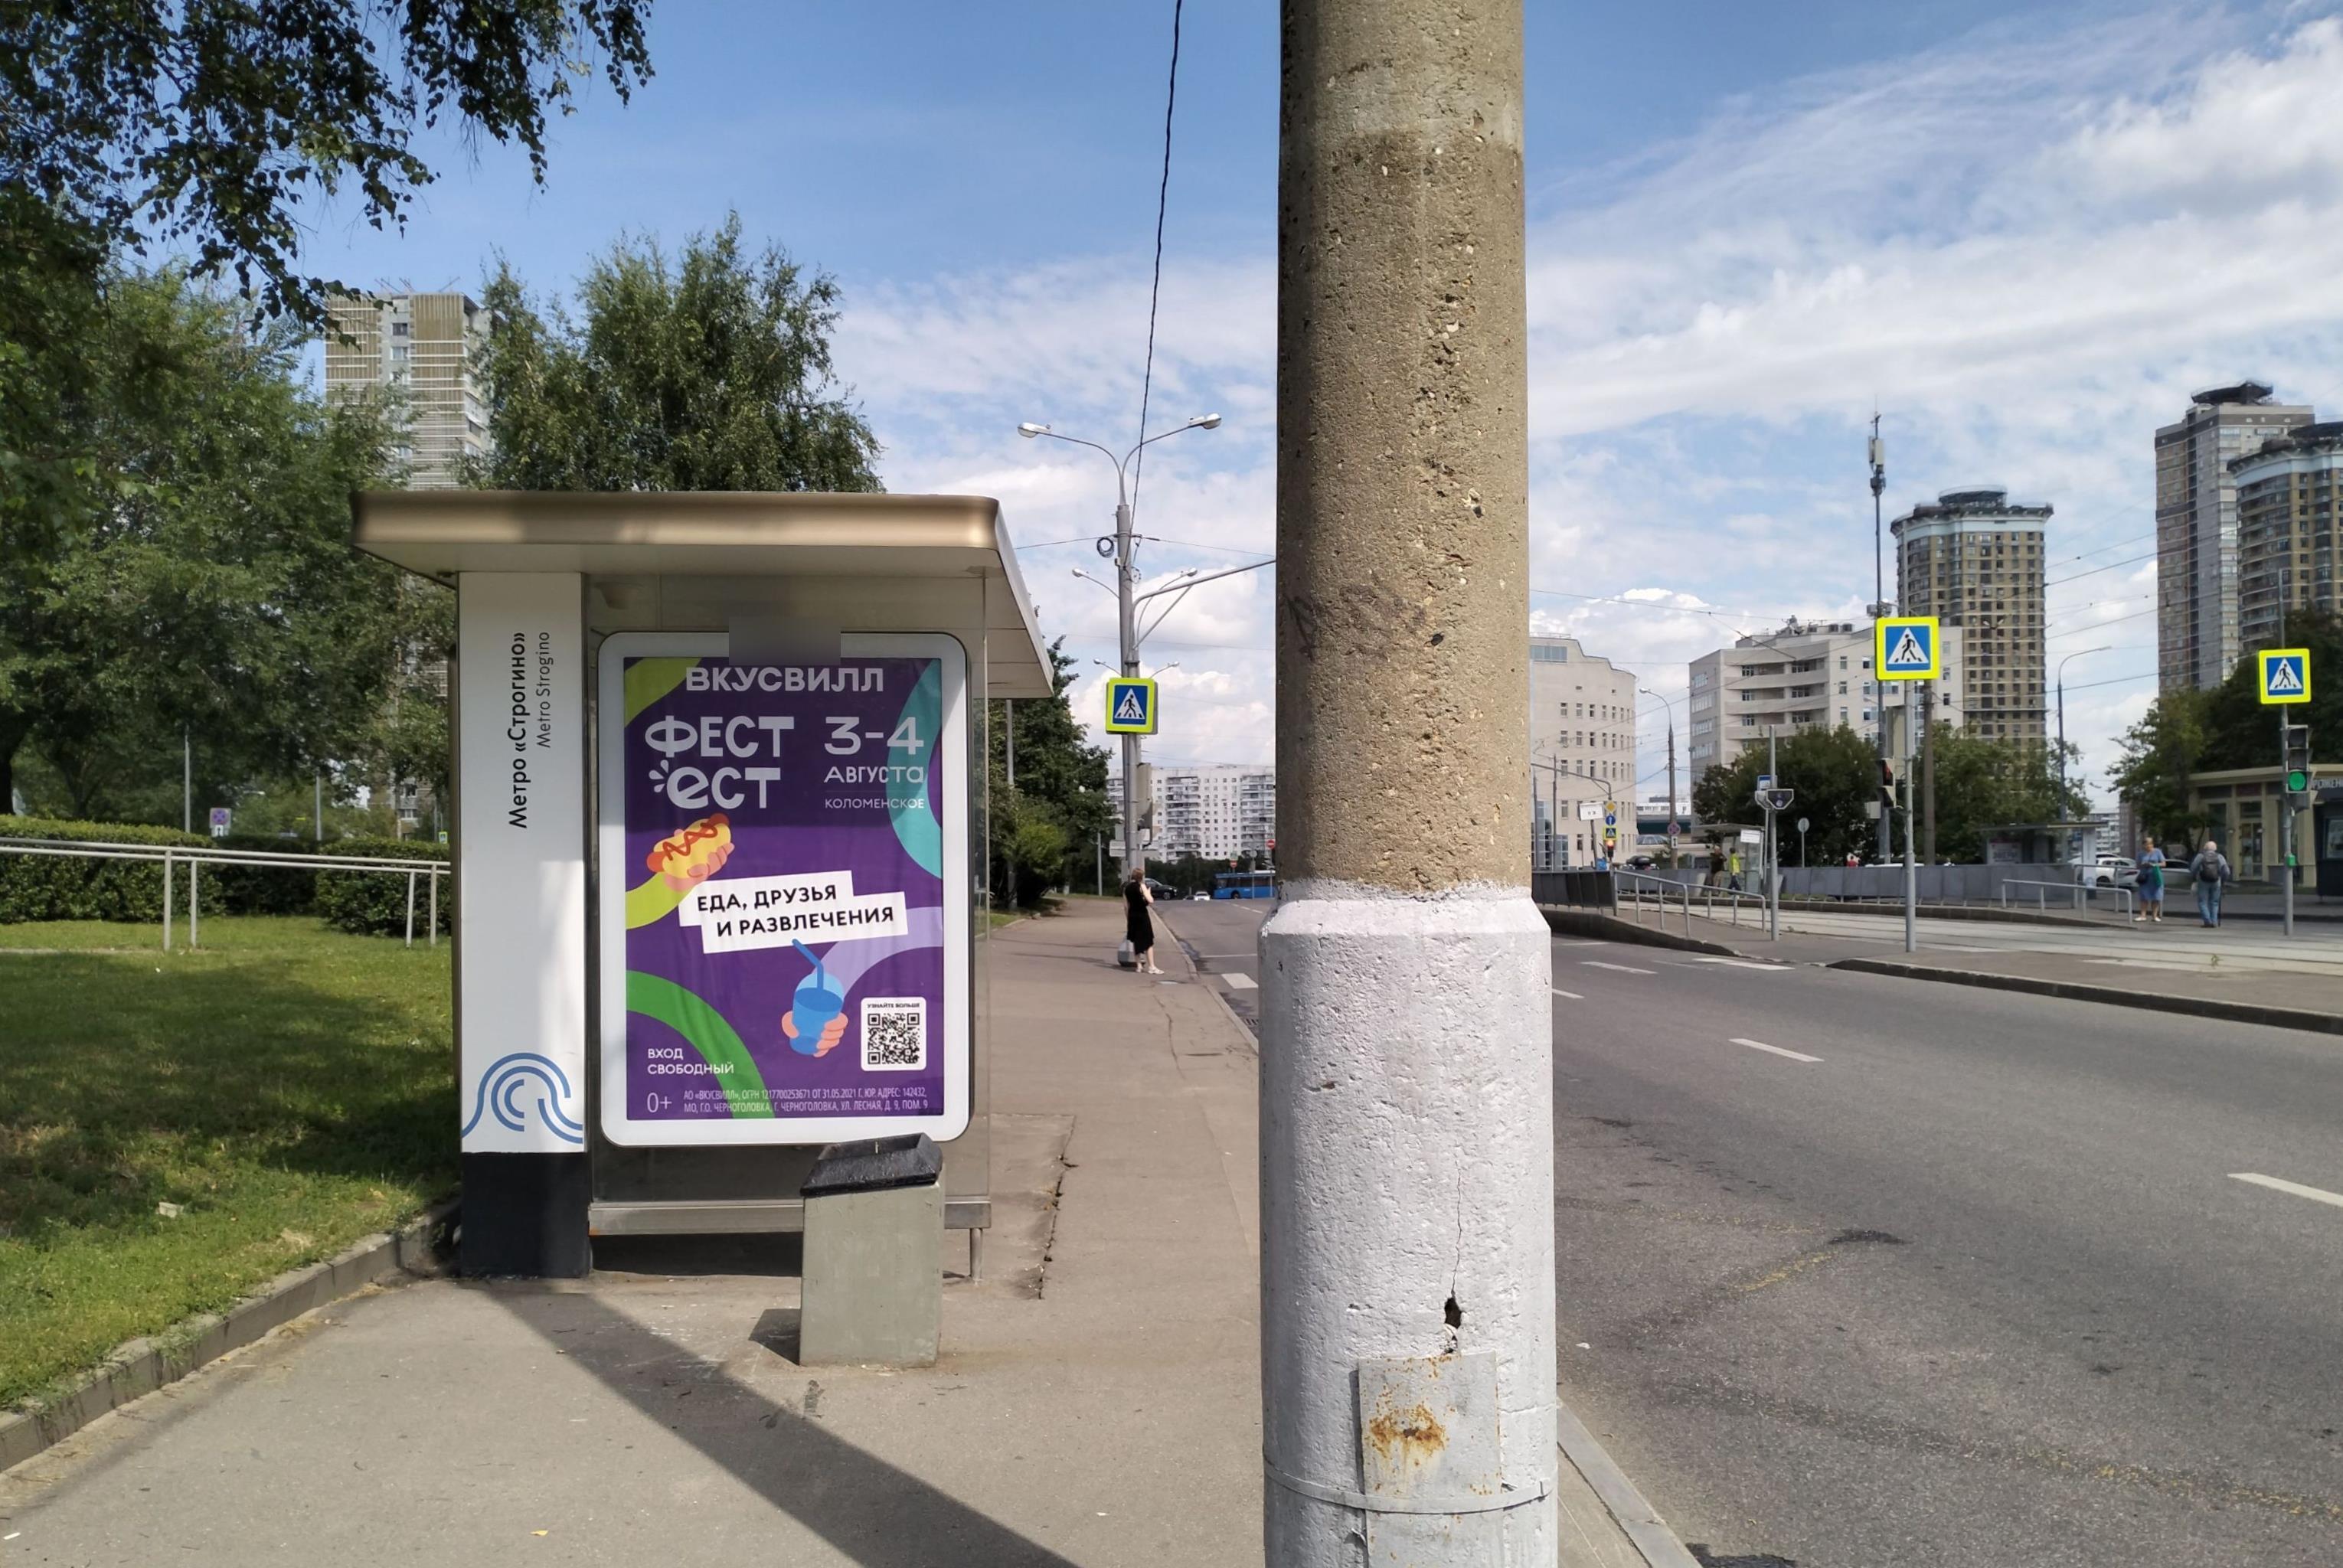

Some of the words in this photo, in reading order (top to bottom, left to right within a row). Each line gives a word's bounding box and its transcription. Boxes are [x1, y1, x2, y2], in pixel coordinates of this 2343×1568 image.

[536, 632, 554, 697] Strogino
[507, 632, 531, 753] «Строгино»
[686, 667, 884, 692] ВКУСВИЛЛ
[536, 701, 551, 749] Metro
[645, 715, 795, 758] ФЕСТ
[508, 758, 531, 828] Метро
[825, 798, 925, 809] КОЛОМЕНСКОЕ
[697, 892, 748, 913] ЕДА,
[754, 885, 837, 907] ДРУЗЬЯ
[717, 921, 733, 937] И
[739, 906, 894, 936] РАЗВЛЕЧЕНИЯ
[648, 1048, 684, 1060] ВХОД
[647, 1062, 734, 1075] СВОБОДНЫЙ
[647, 1093, 672, 1112] 0+
[684, 1089, 694, 1100] АО
[694, 1089, 740, 1101] «ВКУСВИЛЛ»,
[742, 1089, 760, 1099] ОГРН
[762, 1089, 810, 1100] 1217700253671
[812, 1089, 821, 1099] ОТ
[822, 1089, 857, 1099] 31.05.2021
[877, 1088, 900, 1099] АДРЕС:
[903, 1087, 927, 1098] 142432,
[684, 1103, 698, 1114] МО,
[700, 1102, 712, 1112] Г.О.
[782, 1101, 839, 1112] ЧЕРНОГОЛОВКА,
[841, 1101, 851, 1111] УЛ.
[902, 1100, 922, 1109] ПОМ.
[923, 1099, 928, 1109] 9
